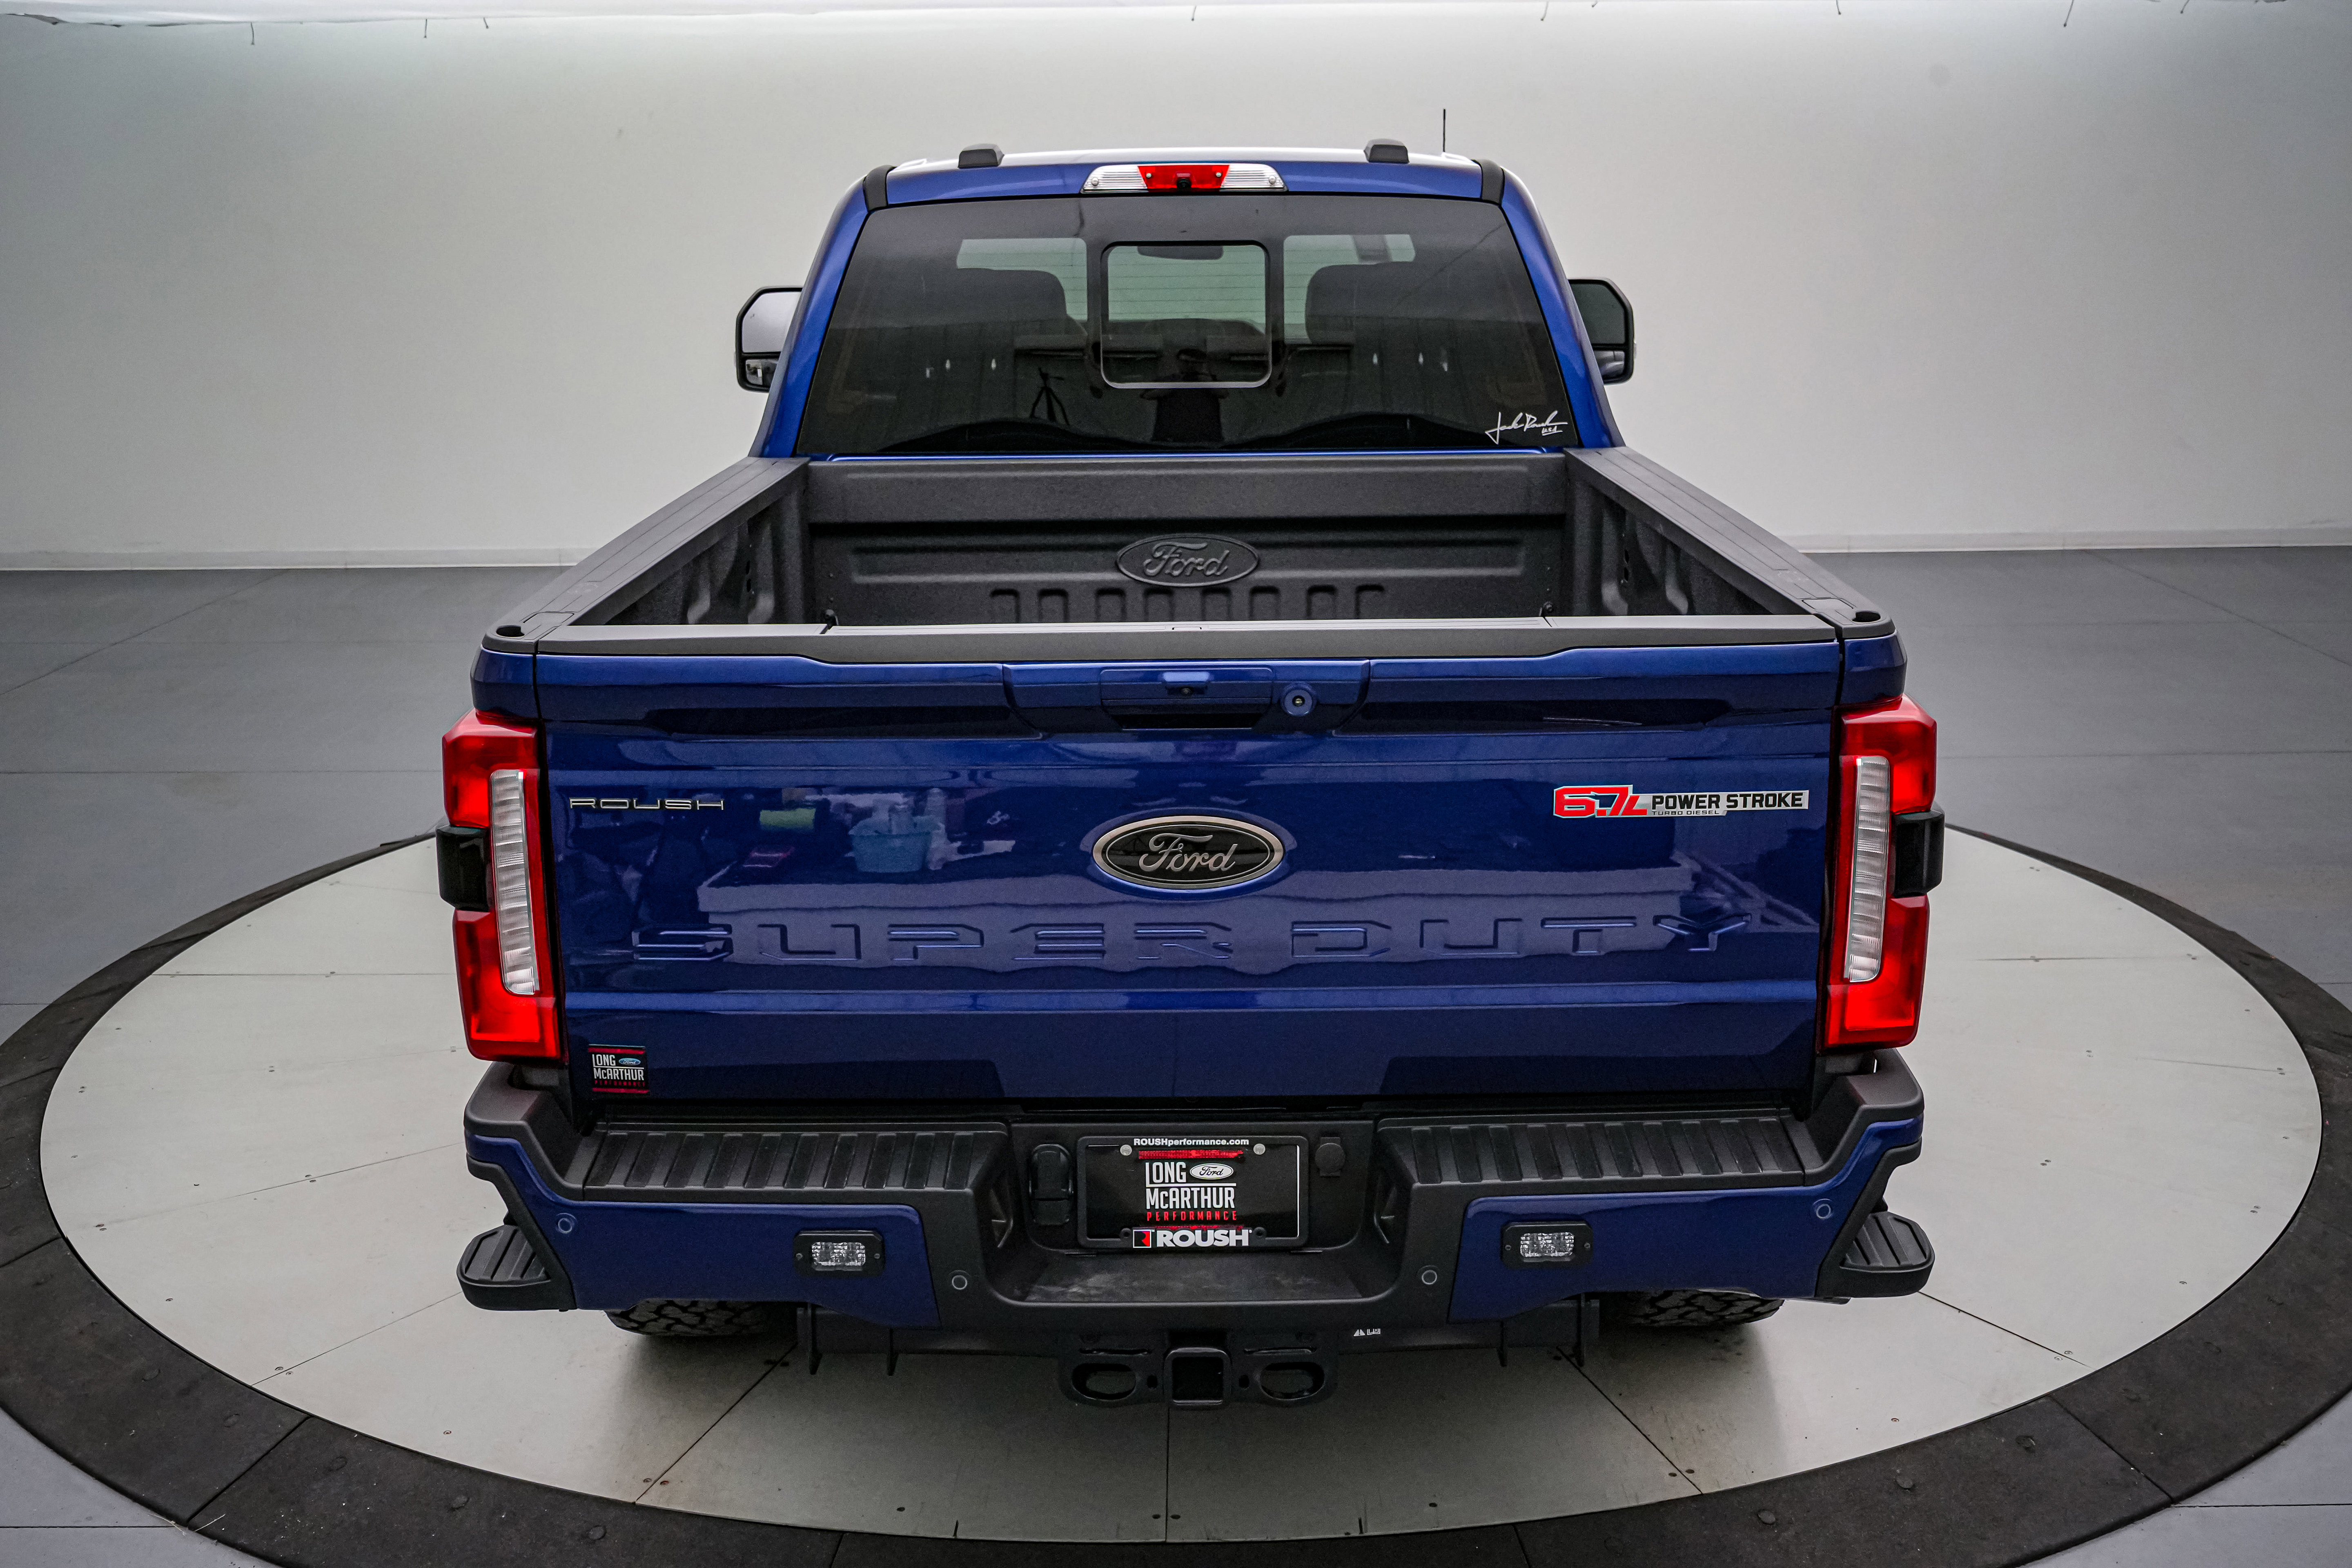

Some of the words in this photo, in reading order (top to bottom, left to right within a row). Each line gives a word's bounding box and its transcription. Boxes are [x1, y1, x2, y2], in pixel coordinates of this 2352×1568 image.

[1144, 542, 1230, 576] Ford
[570, 797, 724, 810] ROUSH
[1553, 785, 1647, 817] 6.7L
[1652, 794, 1720, 810] POWER
[1726, 792, 1803, 808] STROKE
[1138, 833, 1238, 871] Ford
[632, 922, 1233, 963] SUPER
[1291, 913, 1751, 958] DUTY
[592, 1054, 616, 1067] LONG
[593, 1068, 644, 1080] McARTHUR
[1134, 1138, 1249, 1147] ROUSHperformance.com
[1145, 1162, 1187, 1187] LONG
[1199, 1166, 1224, 1176] Ford
[1146, 1187, 1235, 1209] McARTHUR
[1147, 1210, 1237, 1221] PERFORMANCE
[1156, 1229, 1249, 1247] ROUSH
